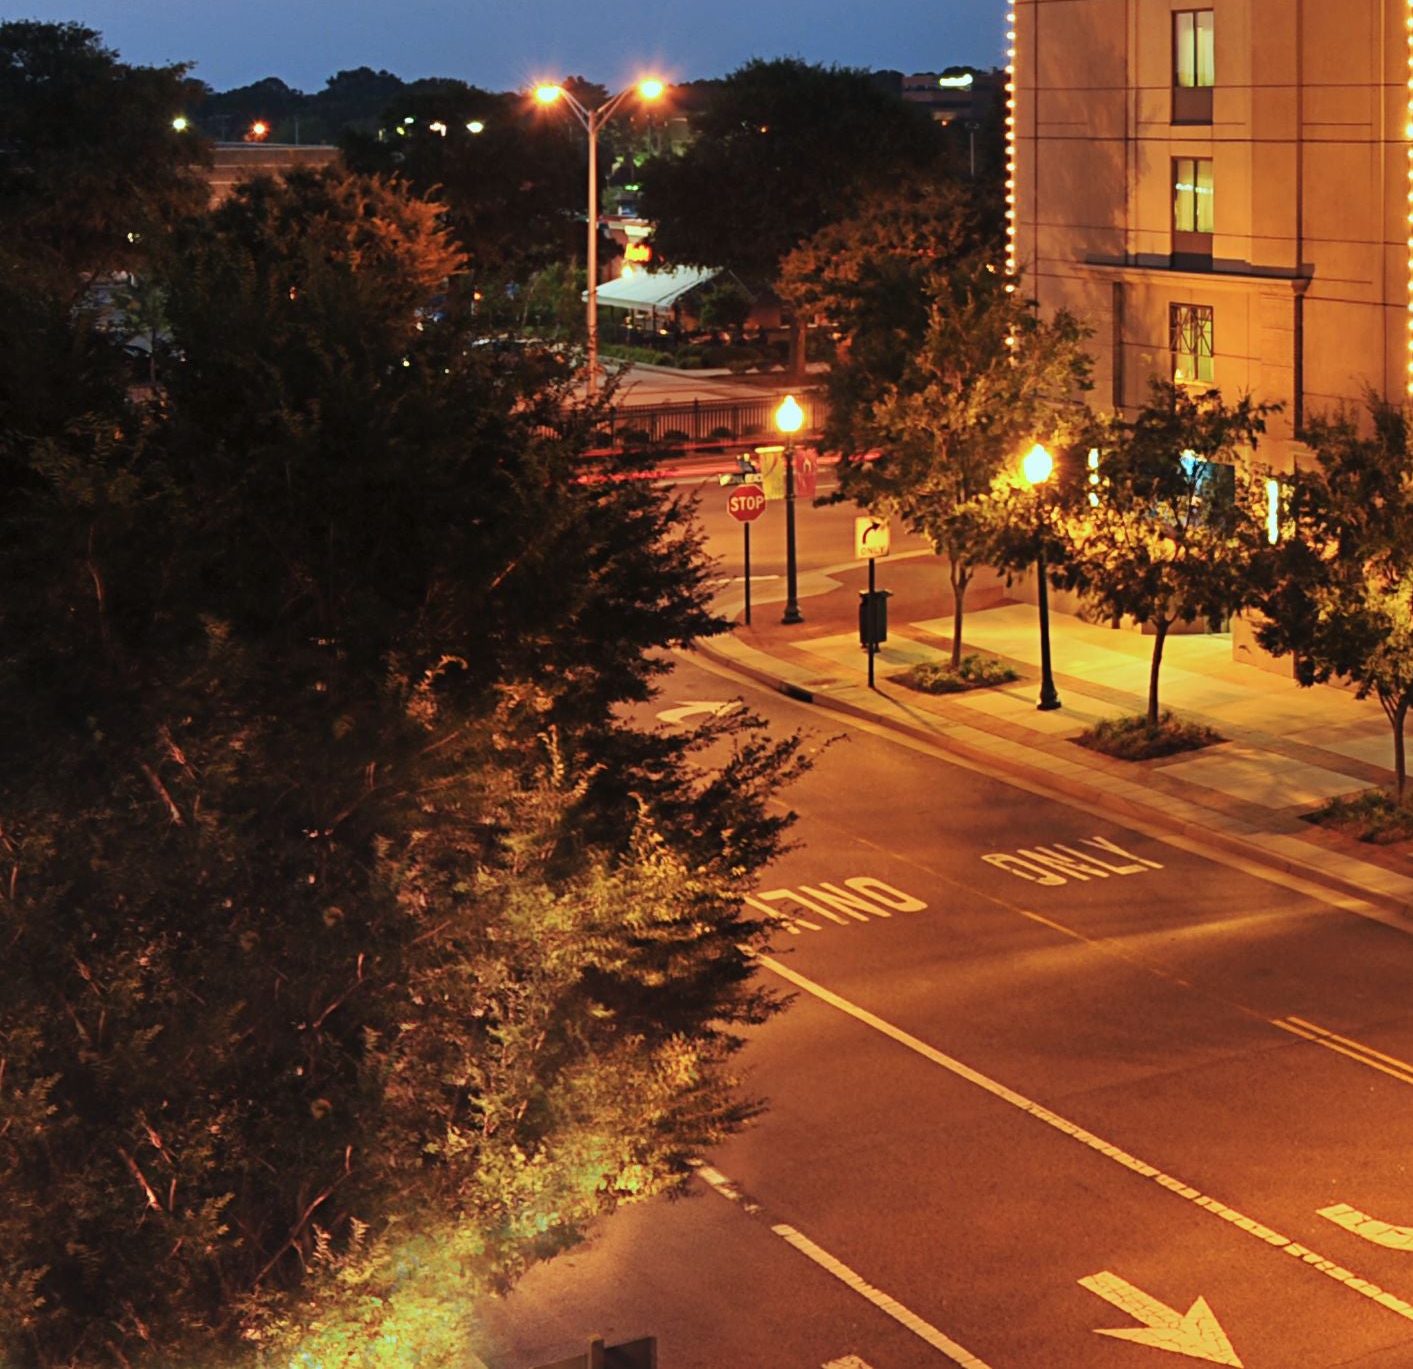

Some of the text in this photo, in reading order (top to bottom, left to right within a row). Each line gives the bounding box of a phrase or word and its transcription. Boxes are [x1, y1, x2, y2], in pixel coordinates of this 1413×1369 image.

[730, 496, 764, 512] STOP
[860, 546, 885, 555] ONLY
[981, 836, 1163, 886] ONLY
